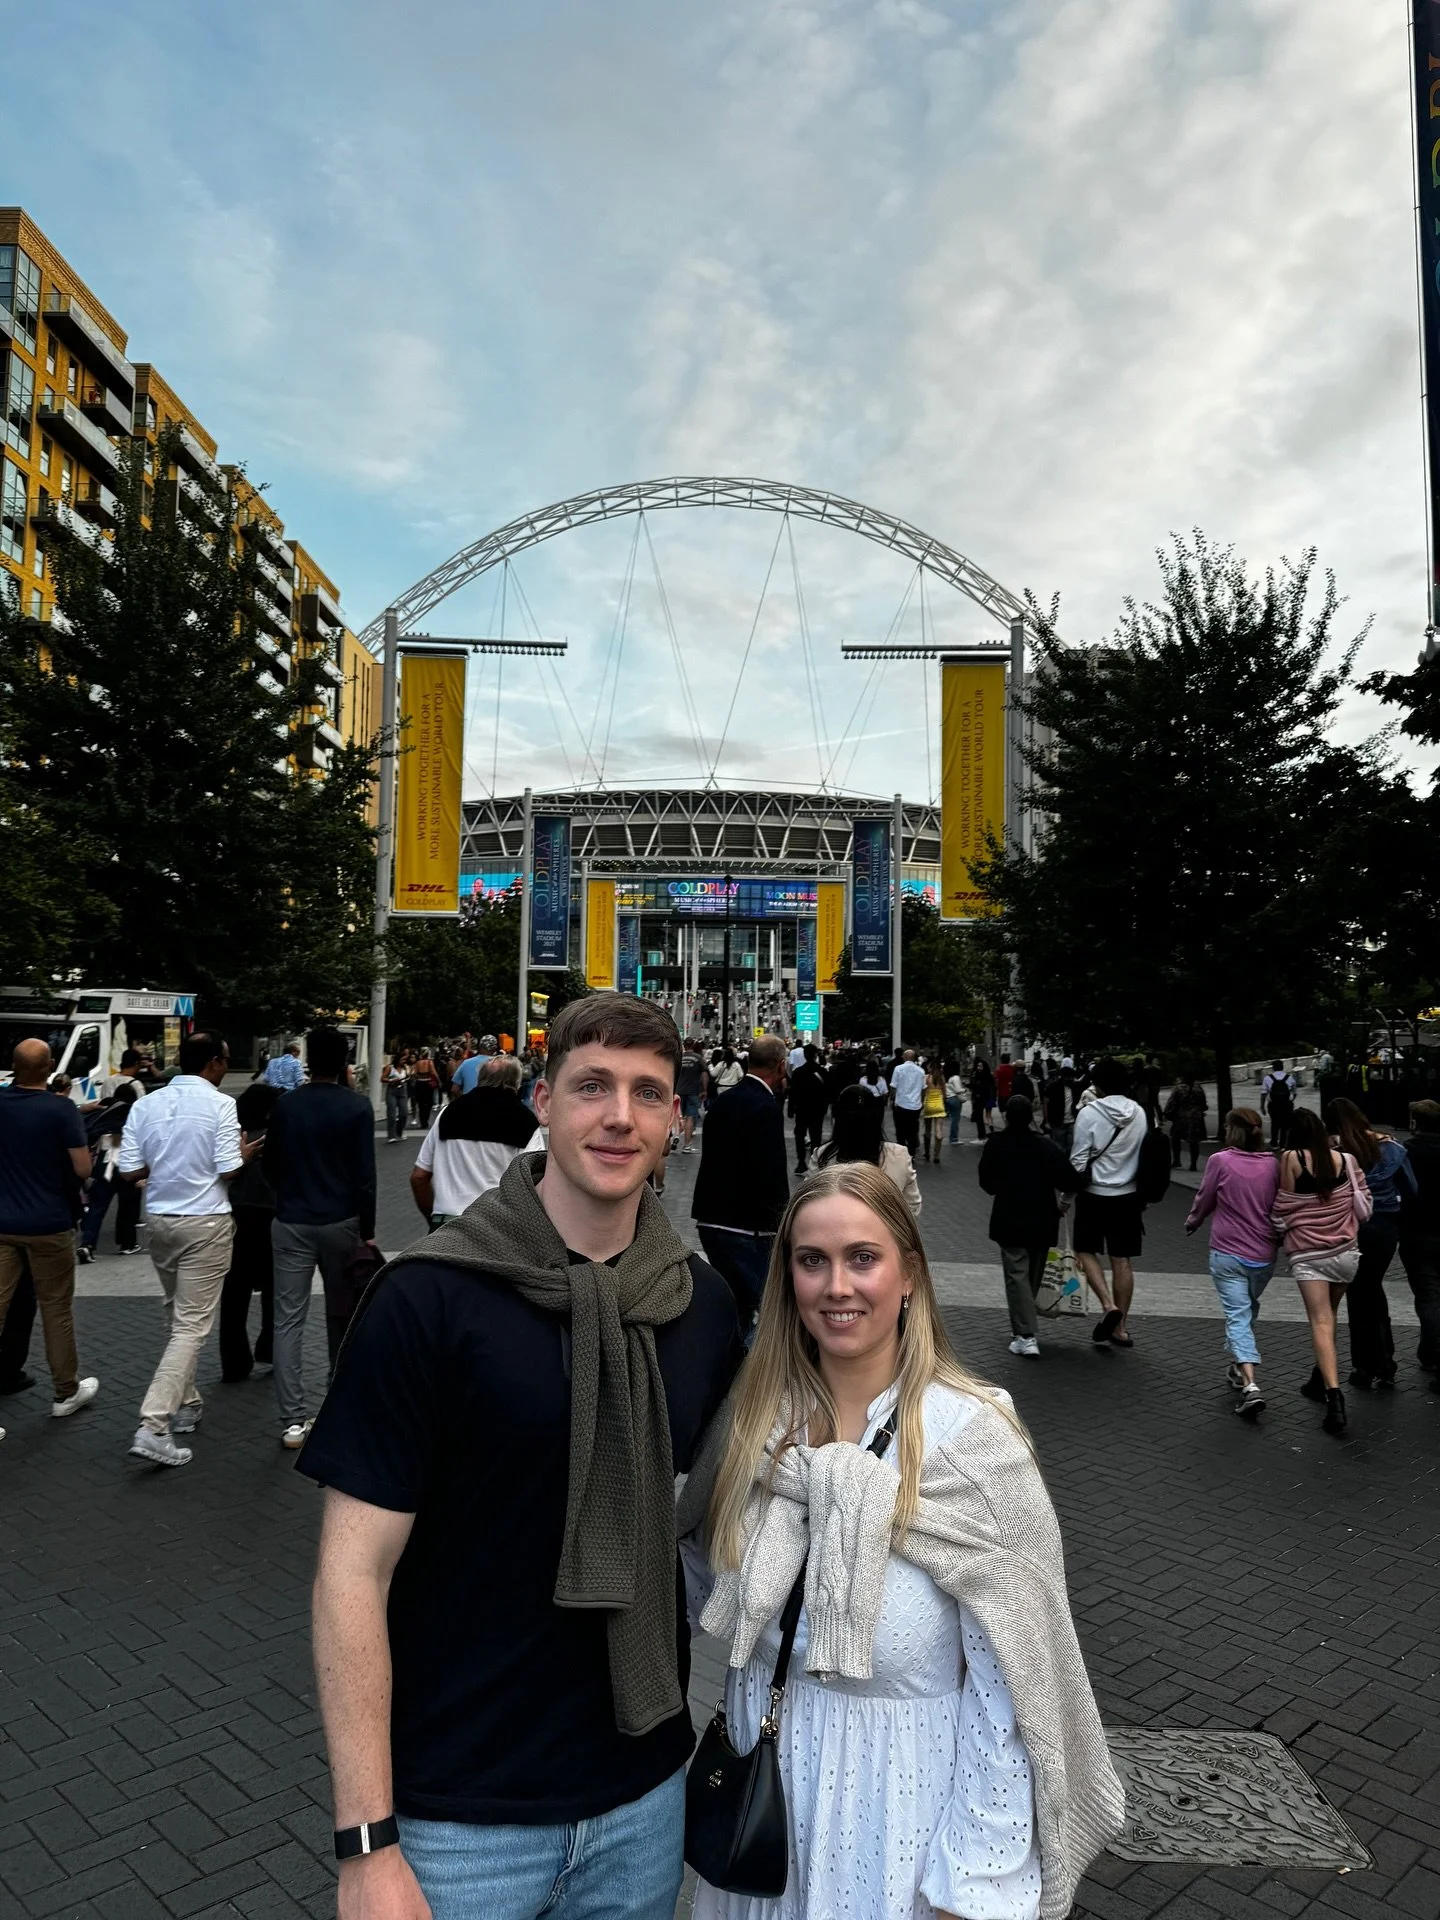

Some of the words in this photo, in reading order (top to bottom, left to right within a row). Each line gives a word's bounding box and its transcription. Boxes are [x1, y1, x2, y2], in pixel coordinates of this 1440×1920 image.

[434, 682, 445, 711] TOUR
[974, 688, 984, 717] TOUR
[421, 703, 431, 725] FOR
[962, 711, 972, 733] FOR
[433, 715, 443, 755] WORLD
[974, 721, 984, 762] WORLD
[419, 727, 431, 785] TOGETHER
[961, 735, 972, 793] TOGETHER
[431, 760, 442, 827] SUSTAINABLE
[974, 765, 984, 832] SUSTAINABLE
[417, 787, 428, 841] WORKING
[961, 796, 971, 849] WORKING
[429, 828, 440, 860] MORE
[552, 838, 560, 872] SPHERES
[872, 843, 880, 877] SPHERES
[407, 883, 446, 893] DHL
[534, 831, 551, 920] COLDPLAY
[668, 882, 739, 895] COLDPLAY
[855, 835, 870, 925] COLDPLAY
[551, 886, 560, 913] MUSIC
[766, 891, 796, 900] MOON
[872, 892, 880, 917] MUSIC
[1221, 1763, 1289, 1797] Thames
[1125, 1791, 1175, 1819] ames
